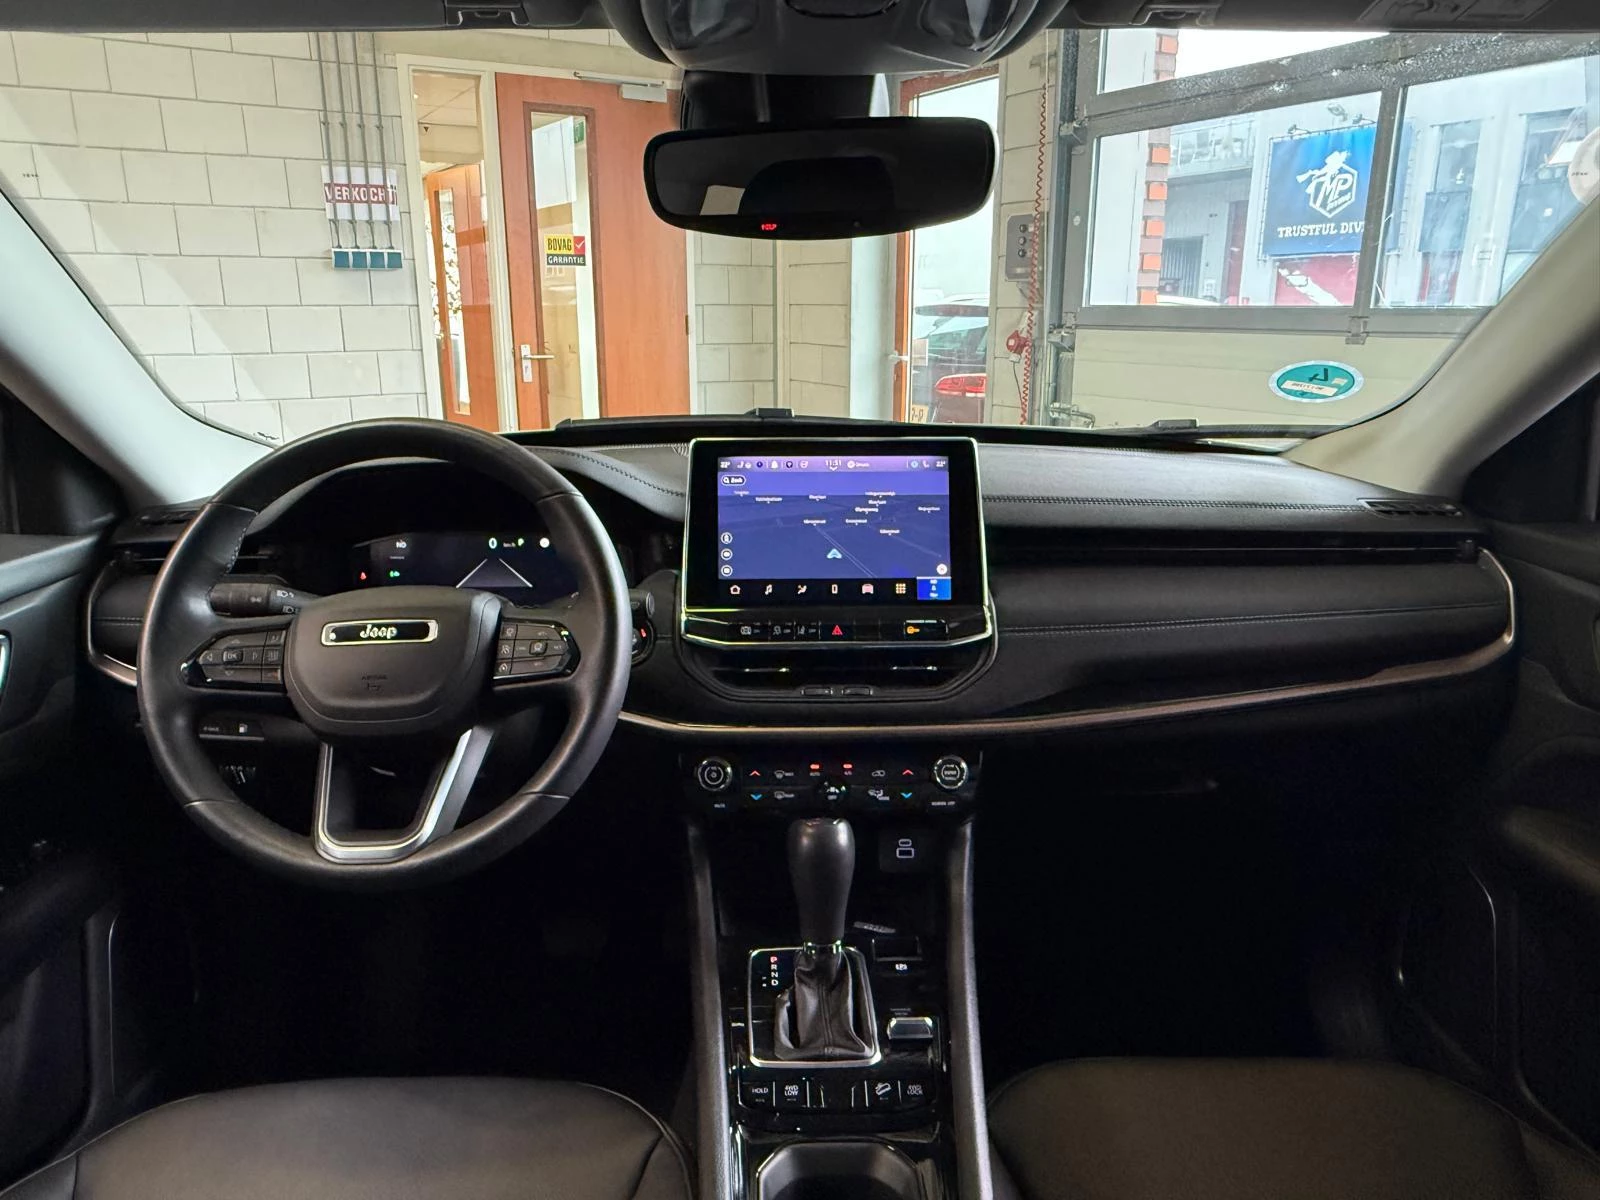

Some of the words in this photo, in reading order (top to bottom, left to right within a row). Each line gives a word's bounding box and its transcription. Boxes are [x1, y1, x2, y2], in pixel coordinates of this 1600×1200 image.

[1277, 223, 1338, 237] TRUSTFUL
[547, 238, 572, 251] BOVAG
[547, 255, 585, 264] GARANTIE
[360, 624, 397, 639] Jeep
